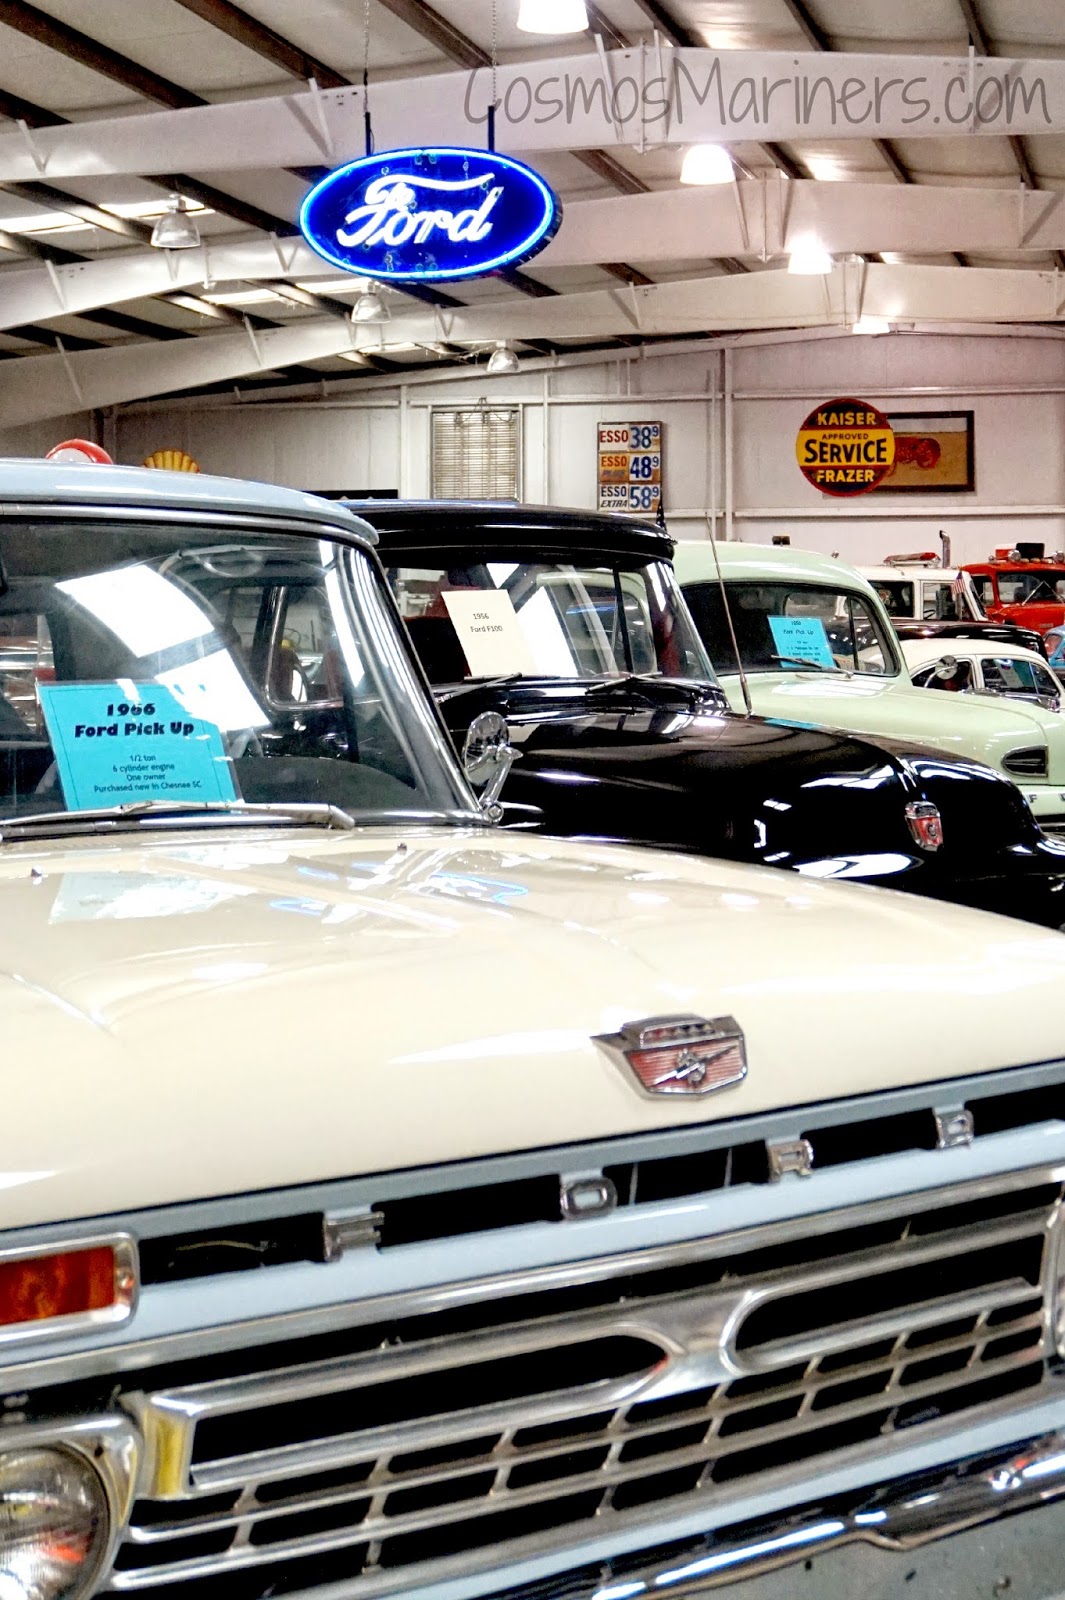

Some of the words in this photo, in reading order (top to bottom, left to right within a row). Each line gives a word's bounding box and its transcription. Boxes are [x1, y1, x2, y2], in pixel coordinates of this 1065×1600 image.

[336, 173, 504, 247] Ford
[817, 412, 877, 426] KAISER
[600, 430, 629, 443] ESSO
[804, 438, 887, 463] SERVICE
[601, 456, 627, 467] ESSO
[816, 469, 875, 483] FRAZER
[601, 486, 627, 497] ESSO
[600, 499, 628, 508] EXTRA
[107, 703, 155, 716] 1966
[74, 723, 118, 738] Ford
[124, 722, 165, 736] Pick
[170, 721, 195, 737] Up
[129, 754, 142, 762] 1/2
[112, 765, 118, 773] 6
[119, 764, 149, 773] cylinder
[150, 763, 175, 772] engine
[94, 784, 133, 793] Purchased
[134, 783, 150, 791] new
[151, 782, 160, 790] in
